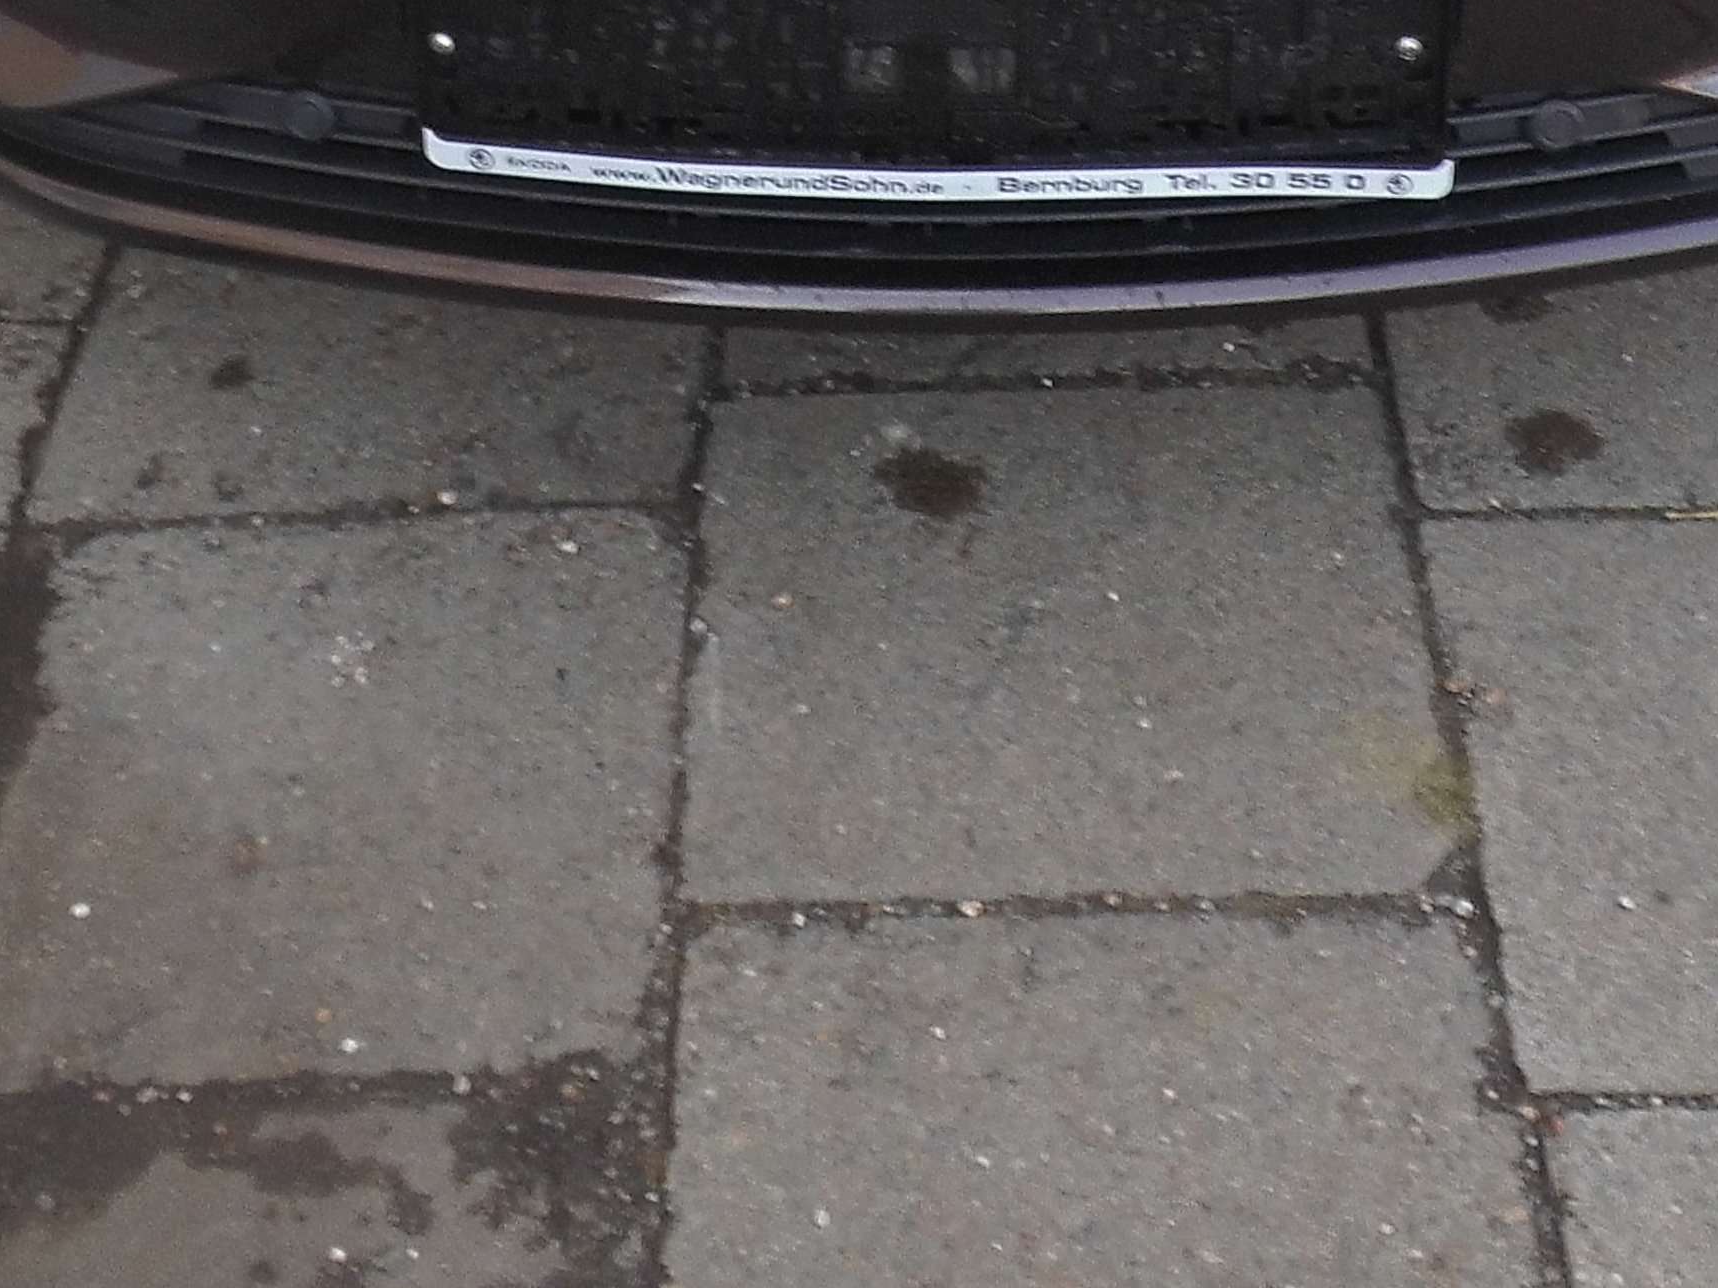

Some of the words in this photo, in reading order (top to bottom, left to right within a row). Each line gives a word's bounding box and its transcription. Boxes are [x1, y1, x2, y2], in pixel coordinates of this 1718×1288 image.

[591, 165, 945, 196] www.WagnerundSohn.de
[998, 175, 1144, 195] Bernburg
[1166, 173, 1215, 191] Tel.
[1230, 172, 1275, 191] 30
[1288, 172, 1332, 190] 55
